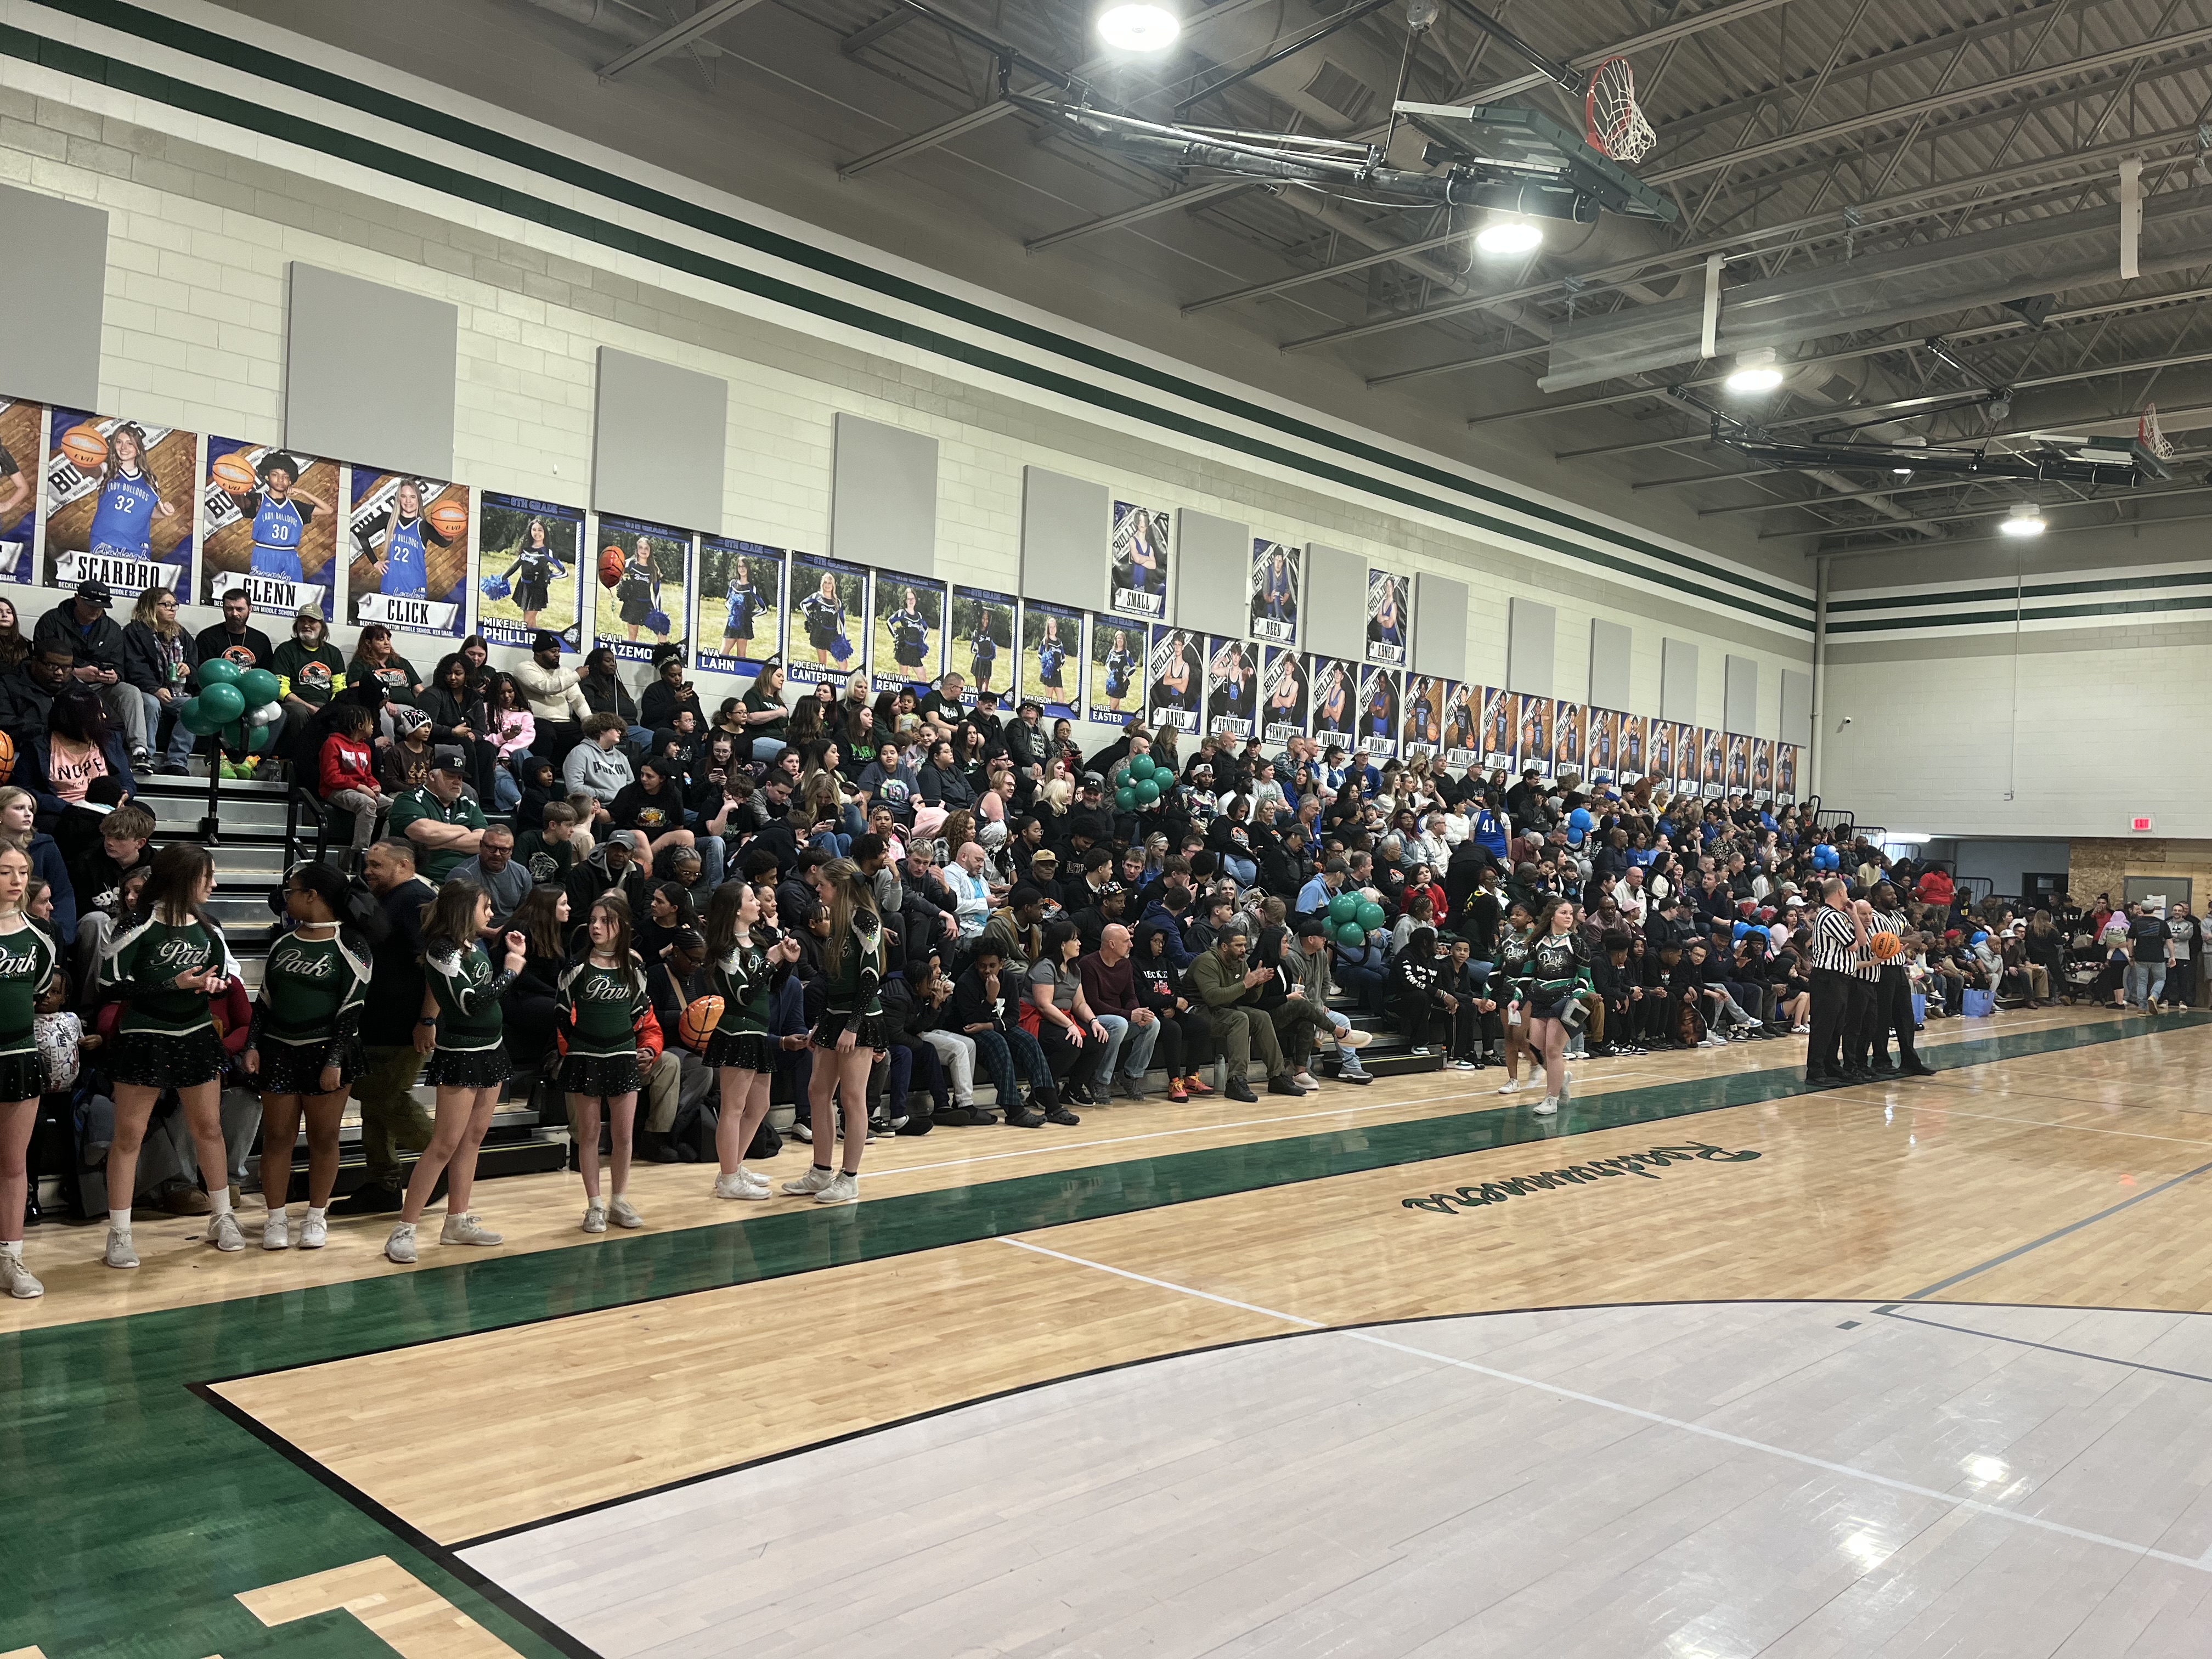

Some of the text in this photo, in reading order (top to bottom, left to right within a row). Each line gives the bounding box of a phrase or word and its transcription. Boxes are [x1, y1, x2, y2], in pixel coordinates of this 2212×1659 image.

[122, 482, 149, 502] BULLDOGS
[115, 495, 135, 514] 32
[529, 500, 558, 514] GRADE
[262, 513, 273, 522] LADY
[272, 524, 289, 540] 30
[398, 534, 419, 549] BULLDOGS
[394, 546, 409, 563] 22
[77, 556, 160, 588] SCARBRO
[110, 588, 128, 596] MIDDLE
[243, 578, 296, 607] GLENN
[1127, 591, 1150, 610] SMALL
[278, 609, 295, 617] SCHOOL
[387, 599, 429, 624] CLICK
[483, 617, 527, 631] MIKELLE
[1266, 620, 1281, 637] REED
[483, 627, 537, 645] PHILLIP
[599, 632, 622, 644] CALI
[702, 647, 720, 657] AVA
[1378, 644, 1395, 659] ABNER
[701, 657, 735, 672] LAHN
[793, 659, 825, 672] JOCELYN
[877, 672, 909, 683] AALIYAH
[876, 681, 902, 692] RENO
[1024, 694, 1052, 704] MADISON
[1093, 703, 1111, 712] CHLOE
[1093, 711, 1122, 724] EASTER
[1166, 710, 1185, 726] DAVIS
[1419, 713, 1425, 725] 2
[1457, 716, 1465, 729] 20
[1218, 718, 1245, 734] HENDRIX
[1322, 732, 1345, 747] WARDEN
[1370, 738, 1387, 753] MANNS
[58, 758, 105, 780] NOPE
[593, 761, 627, 775] PUMA
[1493, 755, 1505, 768] DAVIS
[1531, 760, 1543, 773] JONES
[1482, 819, 1497, 833] 41
[271, 948, 332, 978] Park
[1538, 951, 1564, 968] Park
[1402, 1141, 1762, 1214] Roadrunners
